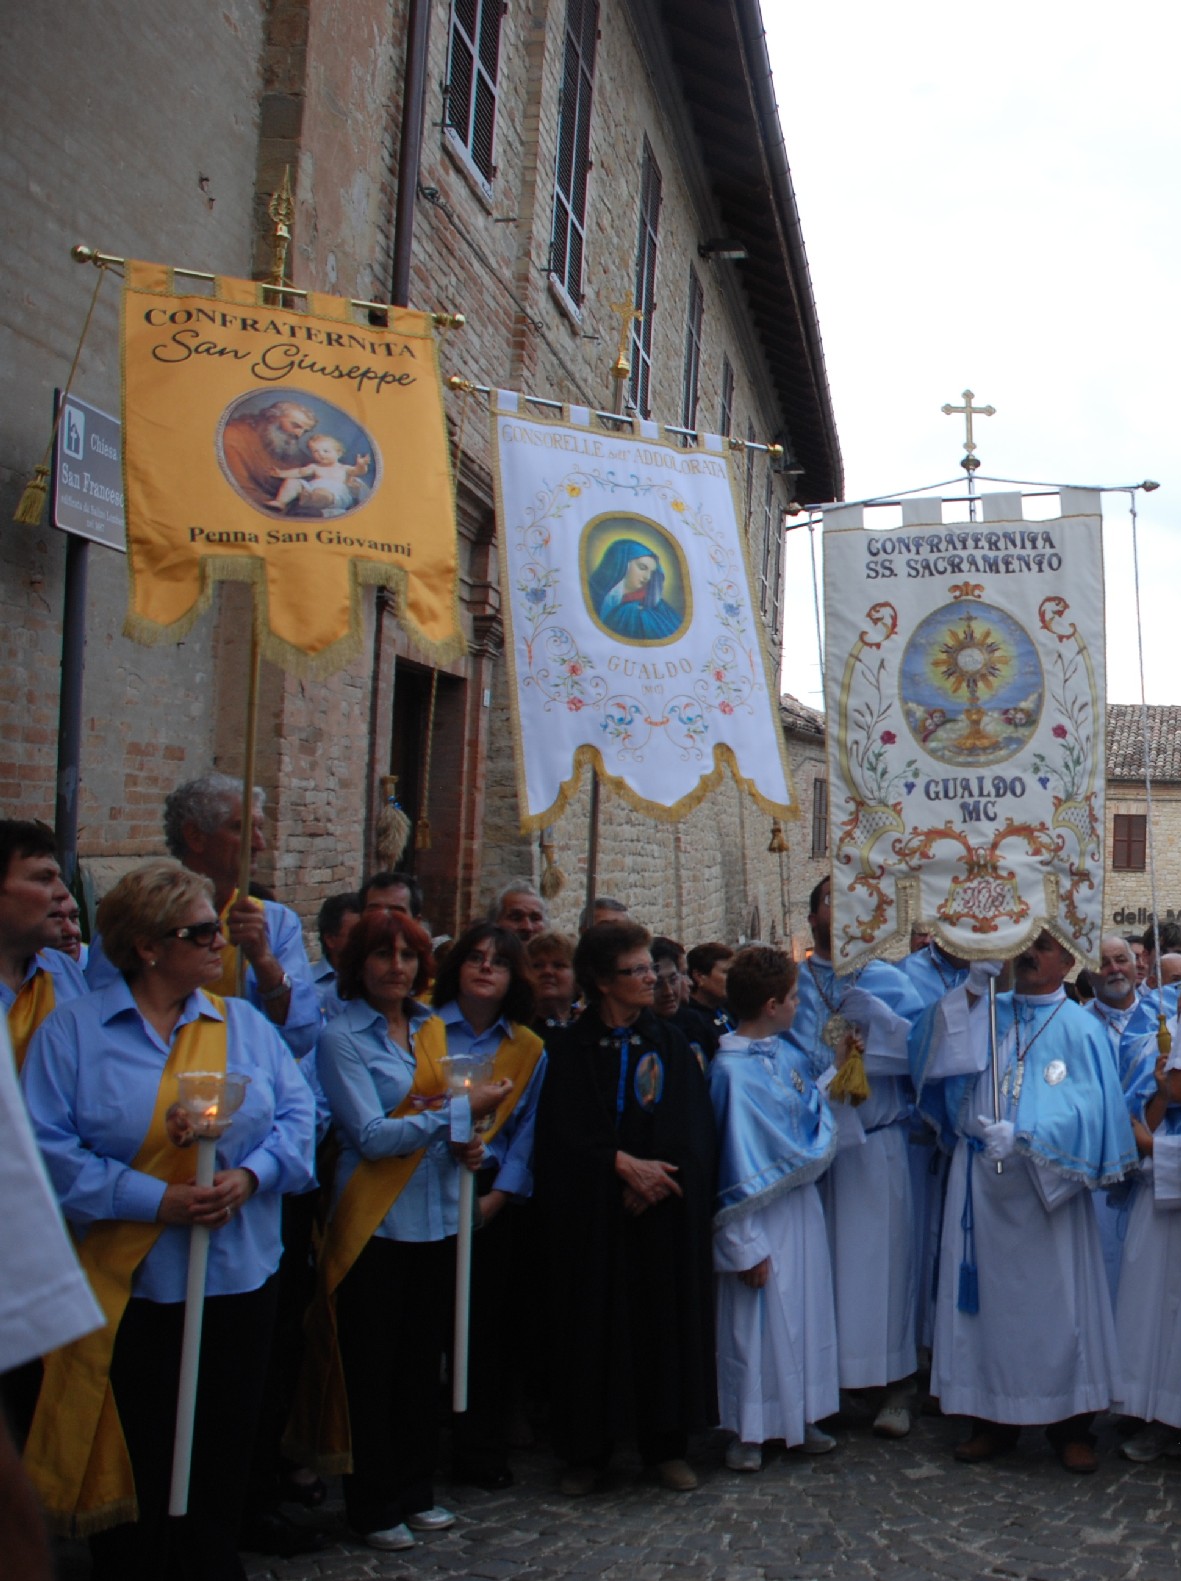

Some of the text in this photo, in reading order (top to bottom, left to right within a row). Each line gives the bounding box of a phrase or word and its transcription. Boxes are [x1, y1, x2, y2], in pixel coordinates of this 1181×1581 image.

[144, 308, 417, 359] CONFRATERNITA
[152, 329, 417, 394] San Giuseppe
[90, 433, 118, 462] Chiesa
[502, 424, 604, 458] CONSORELLE
[636, 449, 728, 480] ADDOLORATA
[61, 462, 125, 508] San Francesc
[189, 527, 412, 558] Penna San Giovanni
[866, 531, 1056, 557] CONFRATERNITA
[865, 552, 1062, 580] SS. SACRAMENTO
[608, 655, 693, 680] GUALDO
[924, 775, 1026, 801] GUALDO
[959, 799, 998, 824] MC
